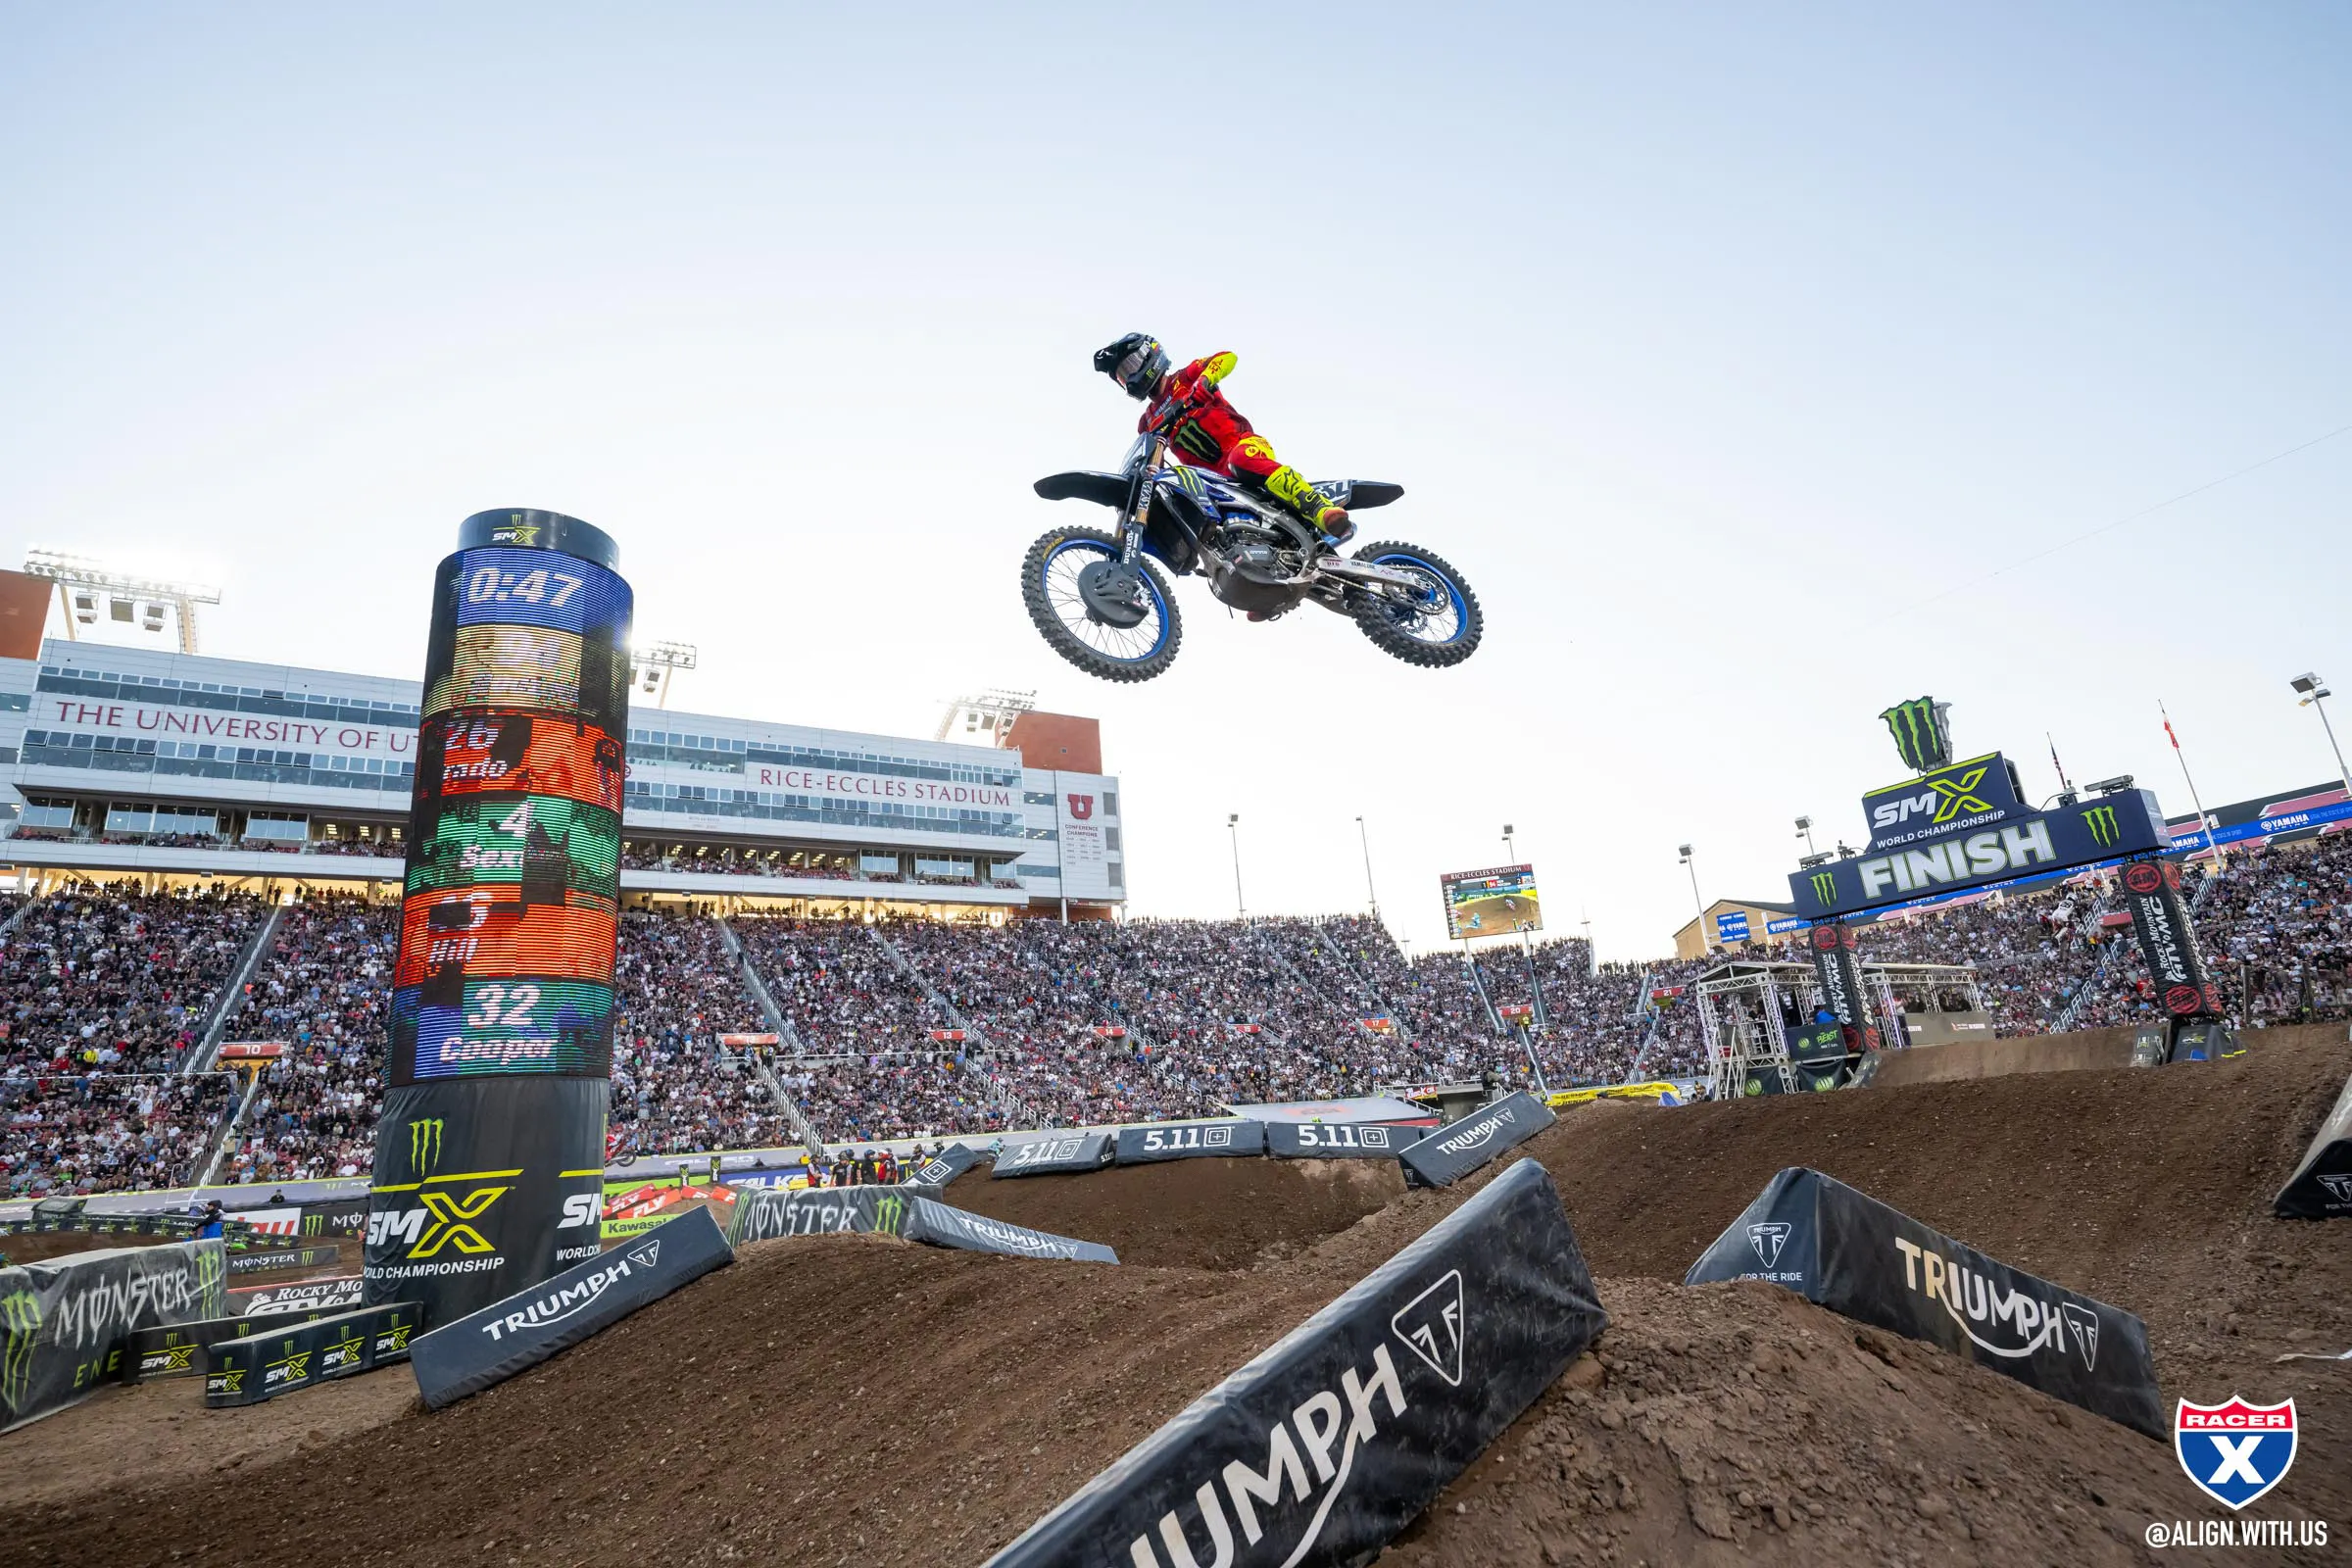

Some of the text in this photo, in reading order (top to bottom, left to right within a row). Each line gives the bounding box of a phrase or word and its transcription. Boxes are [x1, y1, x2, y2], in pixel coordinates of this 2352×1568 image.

[1137, 480, 1153, 511] KYB
[492, 528, 538, 545] SMX
[466, 566, 584, 609] 0:47
[55, 701, 124, 728] THE
[135, 708, 328, 746] UNIVERSITY
[338, 728, 380, 750] OF
[760, 767, 1011, 808] RICE-ECCLES STADIUM
[1873, 766, 1994, 829] SMX
[1876, 809, 2006, 850] WORLD CHAMPIONSHIP
[2271, 813, 2310, 829] YAMAHA
[1857, 818, 2057, 900] FINISH
[1450, 866, 1522, 880] RICE-ECCLES STADIUM
[2139, 897, 2161, 942] MOUNTAIN
[466, 984, 543, 1027] 32
[942, 1030, 954, 1040] 13
[245, 1044, 262, 1055] 10
[1143, 1128, 1200, 1152] 5.11
[1298, 1124, 1359, 1148] 5.11
[1436, 1115, 1503, 1155] TRIUMPH
[1013, 1140, 1058, 1166] 5.11
[557, 1193, 603, 1229] SM
[633, 1195, 666, 1218] FLY
[365, 1186, 509, 1259] SMX
[608, 1217, 668, 1234] Kawasa
[959, 1217, 1058, 1253] TRIUMPH
[232, 1253, 296, 1268] MONSTER
[385, 1256, 506, 1279] CHAMPIONSHIP
[1759, 1272, 1779, 1282] THE
[1780, 1271, 1803, 1282] RIDE
[276, 1284, 334, 1301] ROCKY
[482, 1259, 633, 1342] TRIUMPH
[1894, 1236, 2066, 1357] TRIUMPH
[55, 1266, 194, 1351] MONSTER
[375, 1329, 411, 1350] SMX
[139, 1348, 195, 1370] SMX
[322, 1342, 364, 1366] SMX
[74, 1348, 123, 1388] ENE
[265, 1356, 310, 1384] SMX
[207, 1373, 244, 1392] SMX
